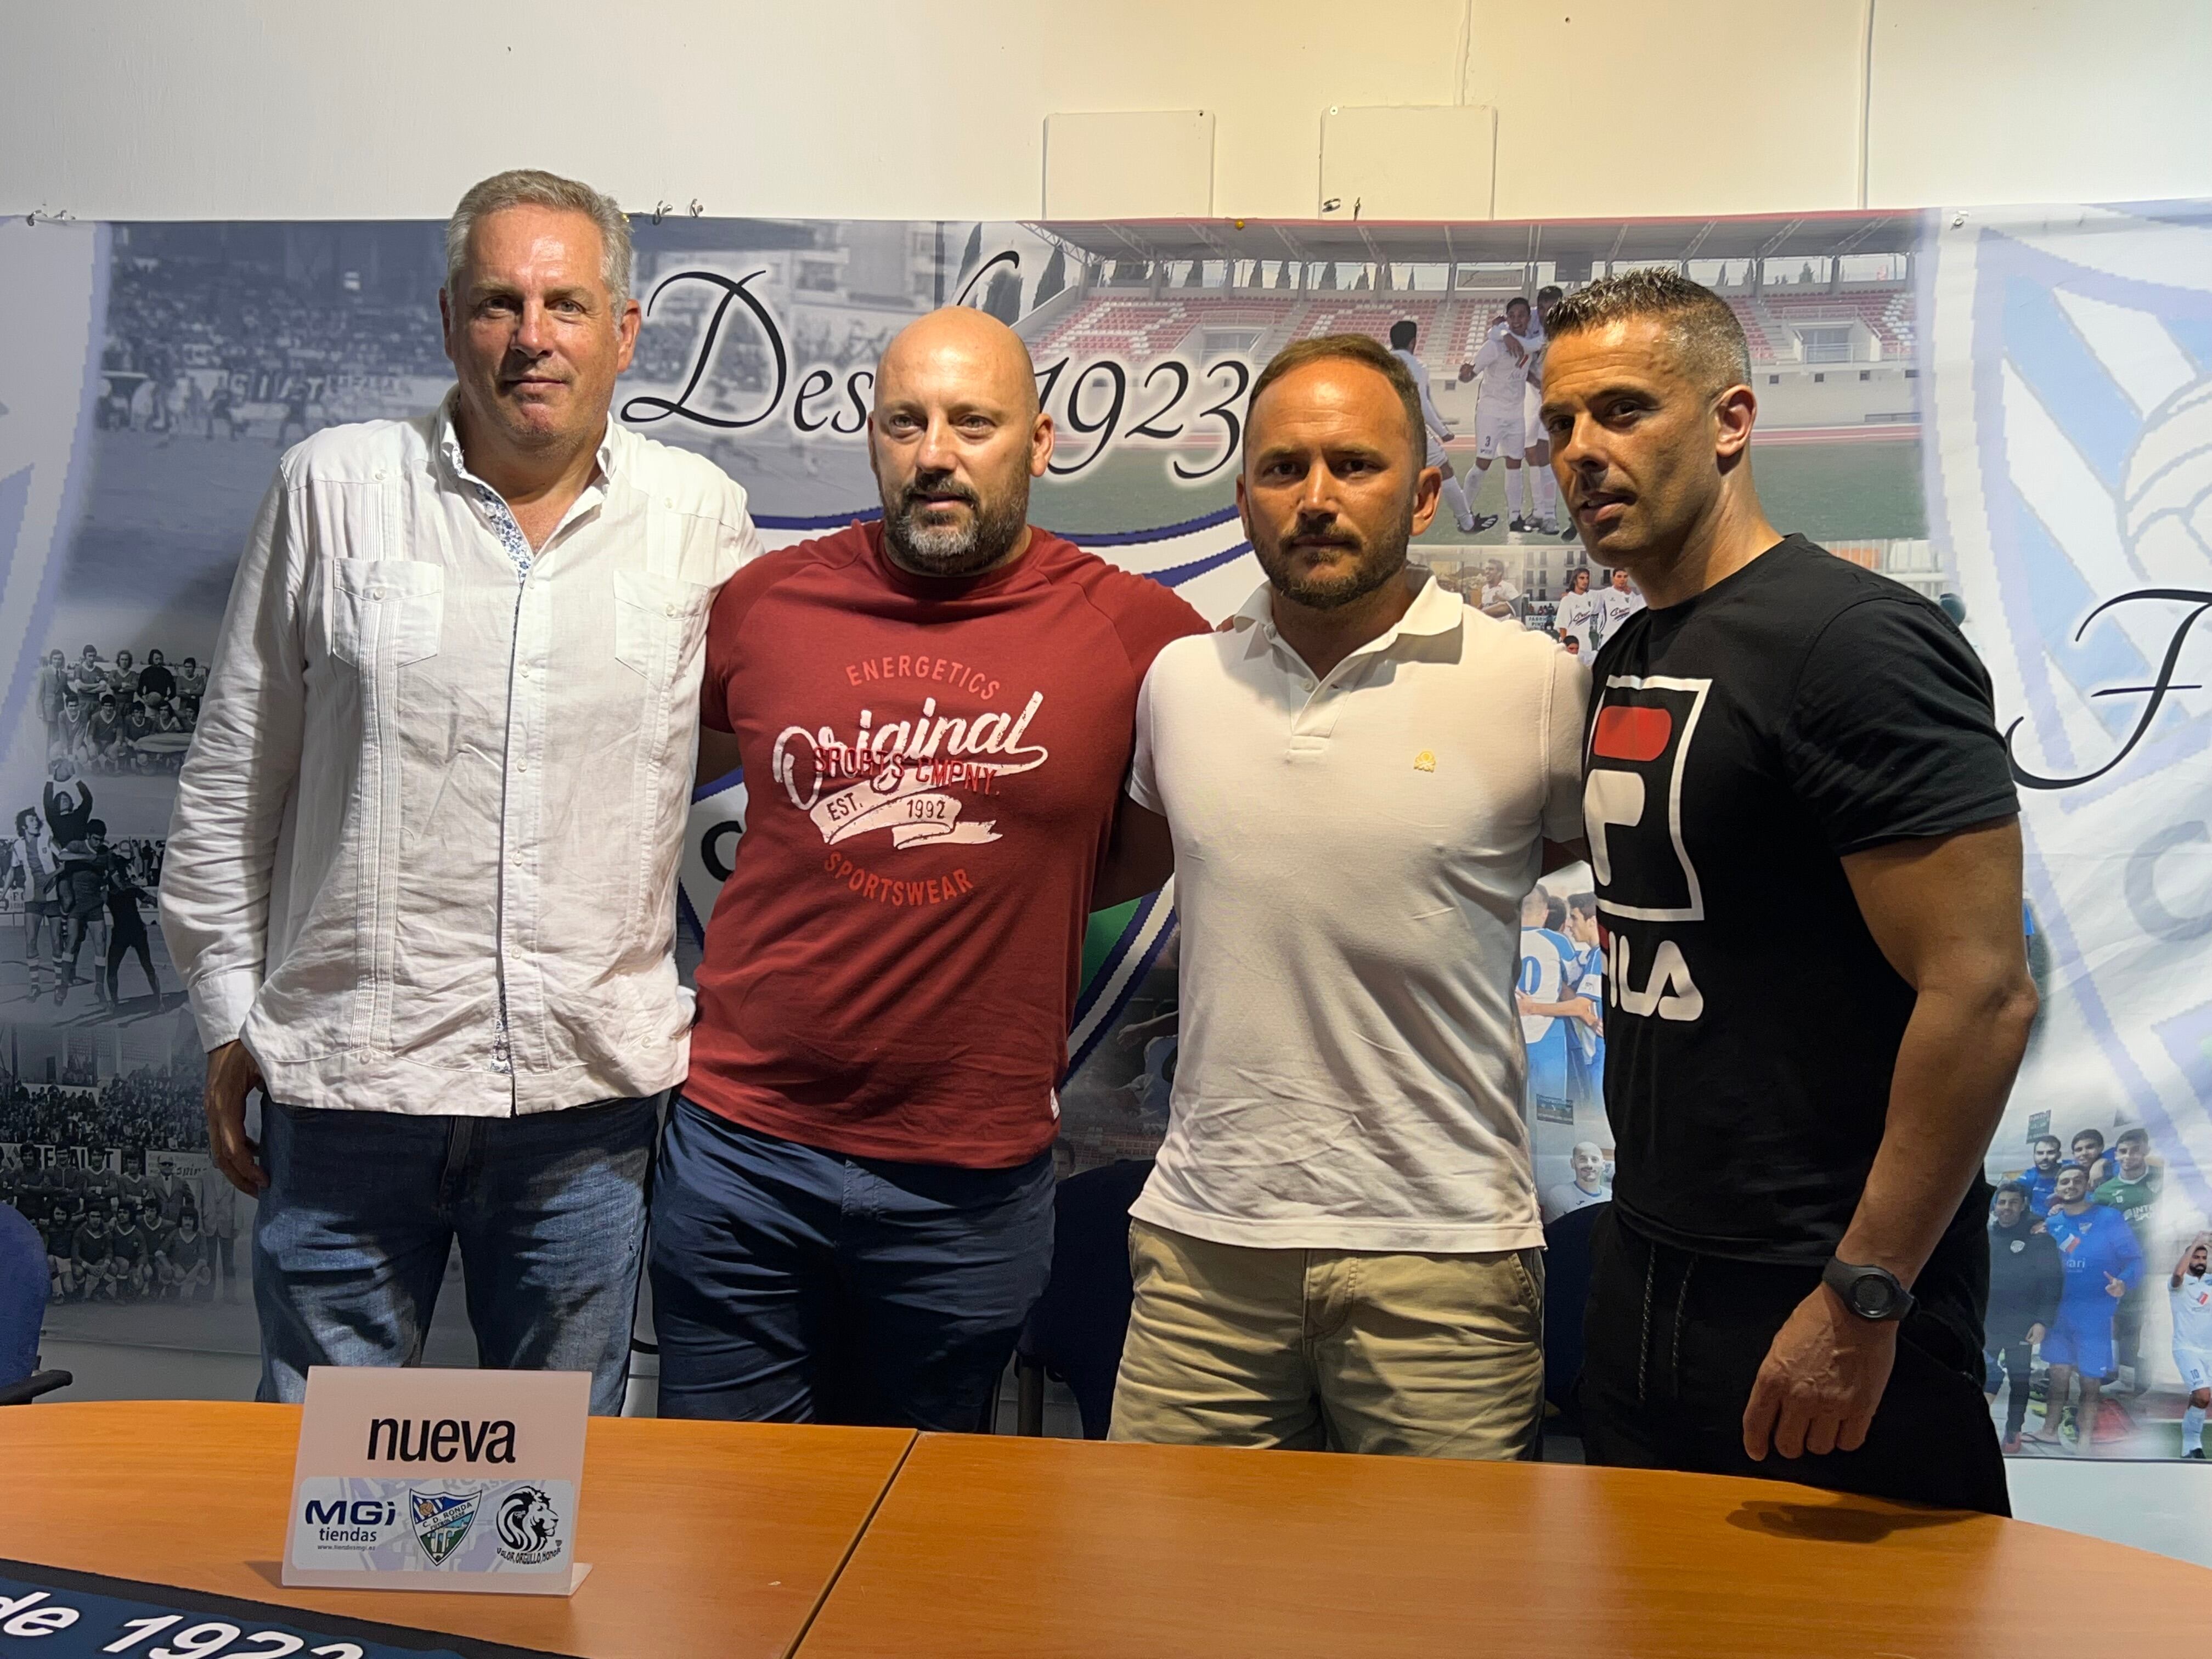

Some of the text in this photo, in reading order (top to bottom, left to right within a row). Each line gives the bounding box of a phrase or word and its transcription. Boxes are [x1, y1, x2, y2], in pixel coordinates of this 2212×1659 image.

[847, 655, 1000, 700] ENERGETICS
[772, 691, 1048, 810] Original
[814, 746, 905, 778] SPORTS
[827, 793, 946, 821] EST. 1992
[825, 851, 974, 907] SPORTSWEAR
[1598, 927, 1703, 1022] ILA
[367, 1418, 516, 1463] nueva
[443, 1502, 473, 1519] RONDA
[319, 1527, 377, 1542] tiendas
